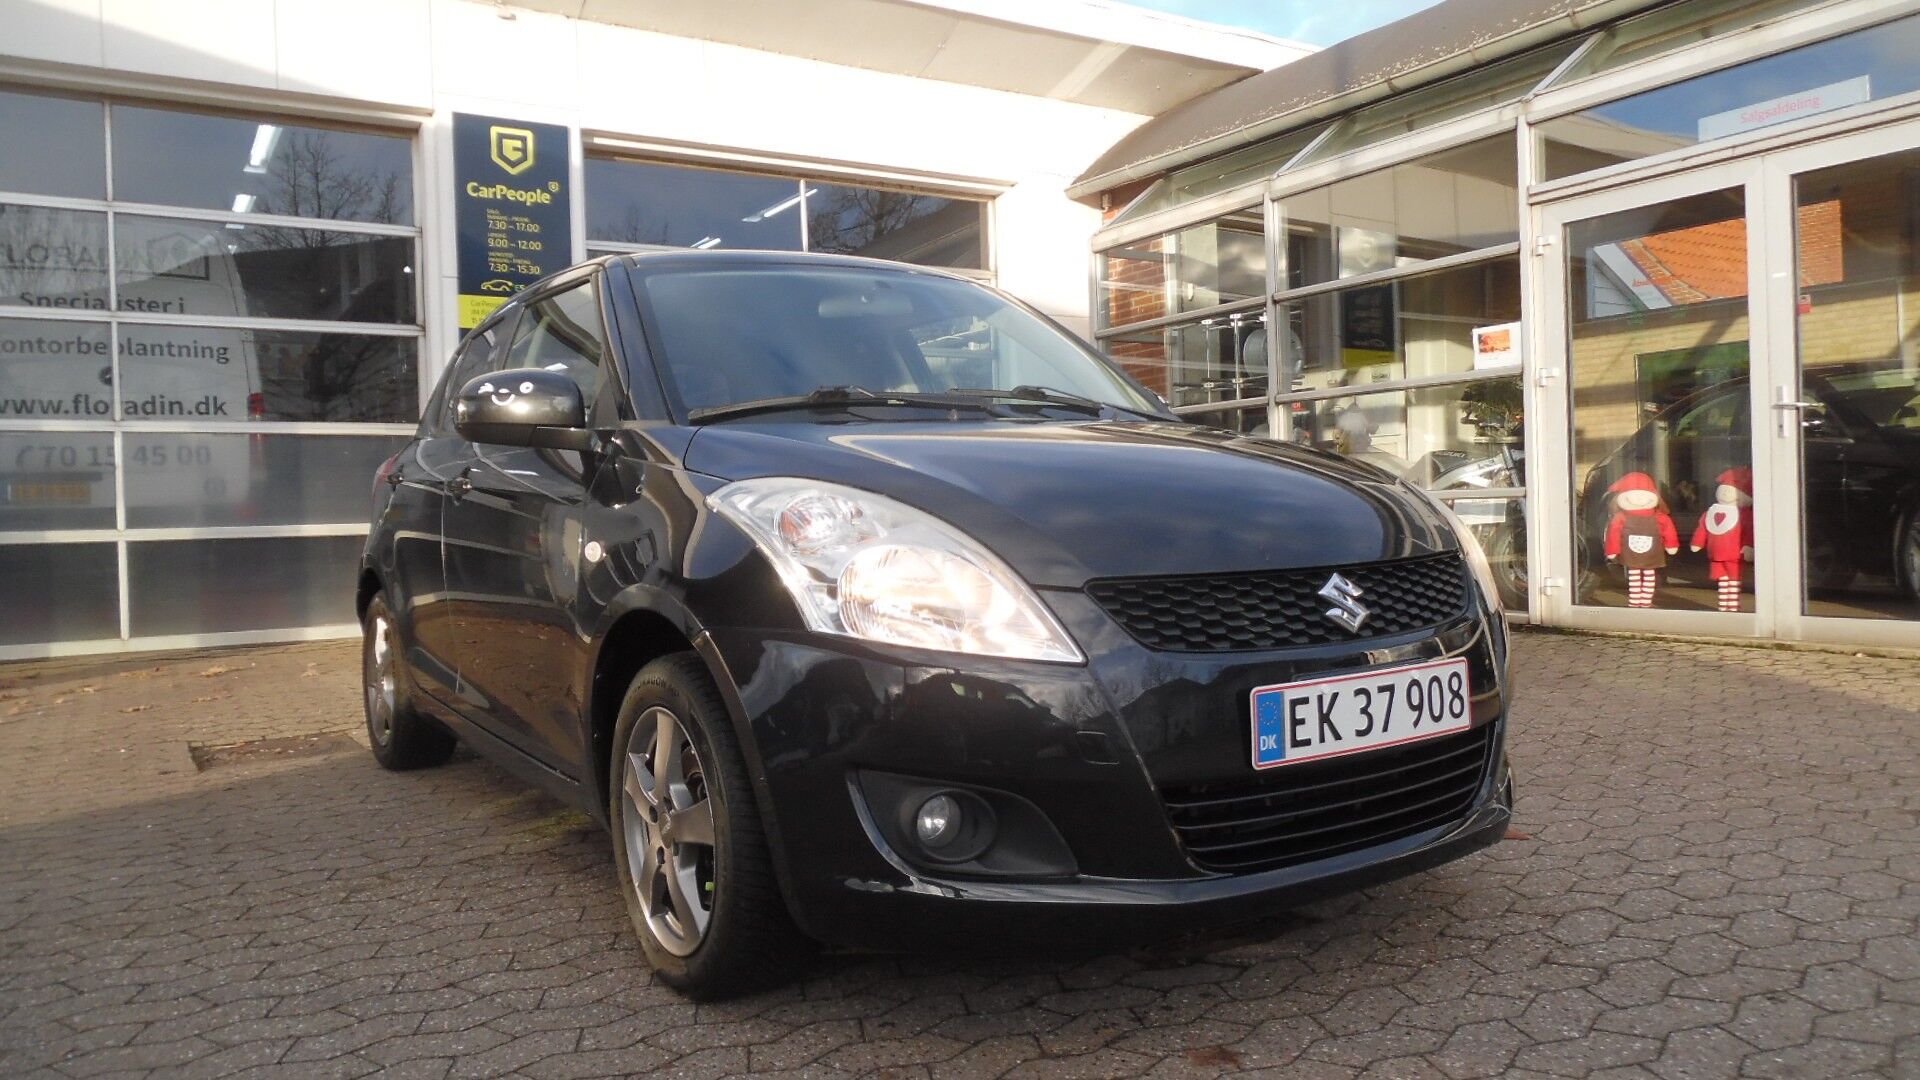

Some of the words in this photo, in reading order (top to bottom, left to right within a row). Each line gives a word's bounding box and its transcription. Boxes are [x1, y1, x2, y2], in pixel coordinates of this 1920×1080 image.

[466, 182, 551, 206] CarPeople
[518, 240, 542, 251] 12.00
[20, 291, 173, 313] Speciaister
[0, 393, 228, 416] ww.floadin.dk
[132, 445, 167, 466] 45
[1289, 691, 1343, 748] EK
[1353, 683, 1396, 737] 37
[1405, 671, 1465, 729] 908
[1260, 734, 1277, 751] DK
